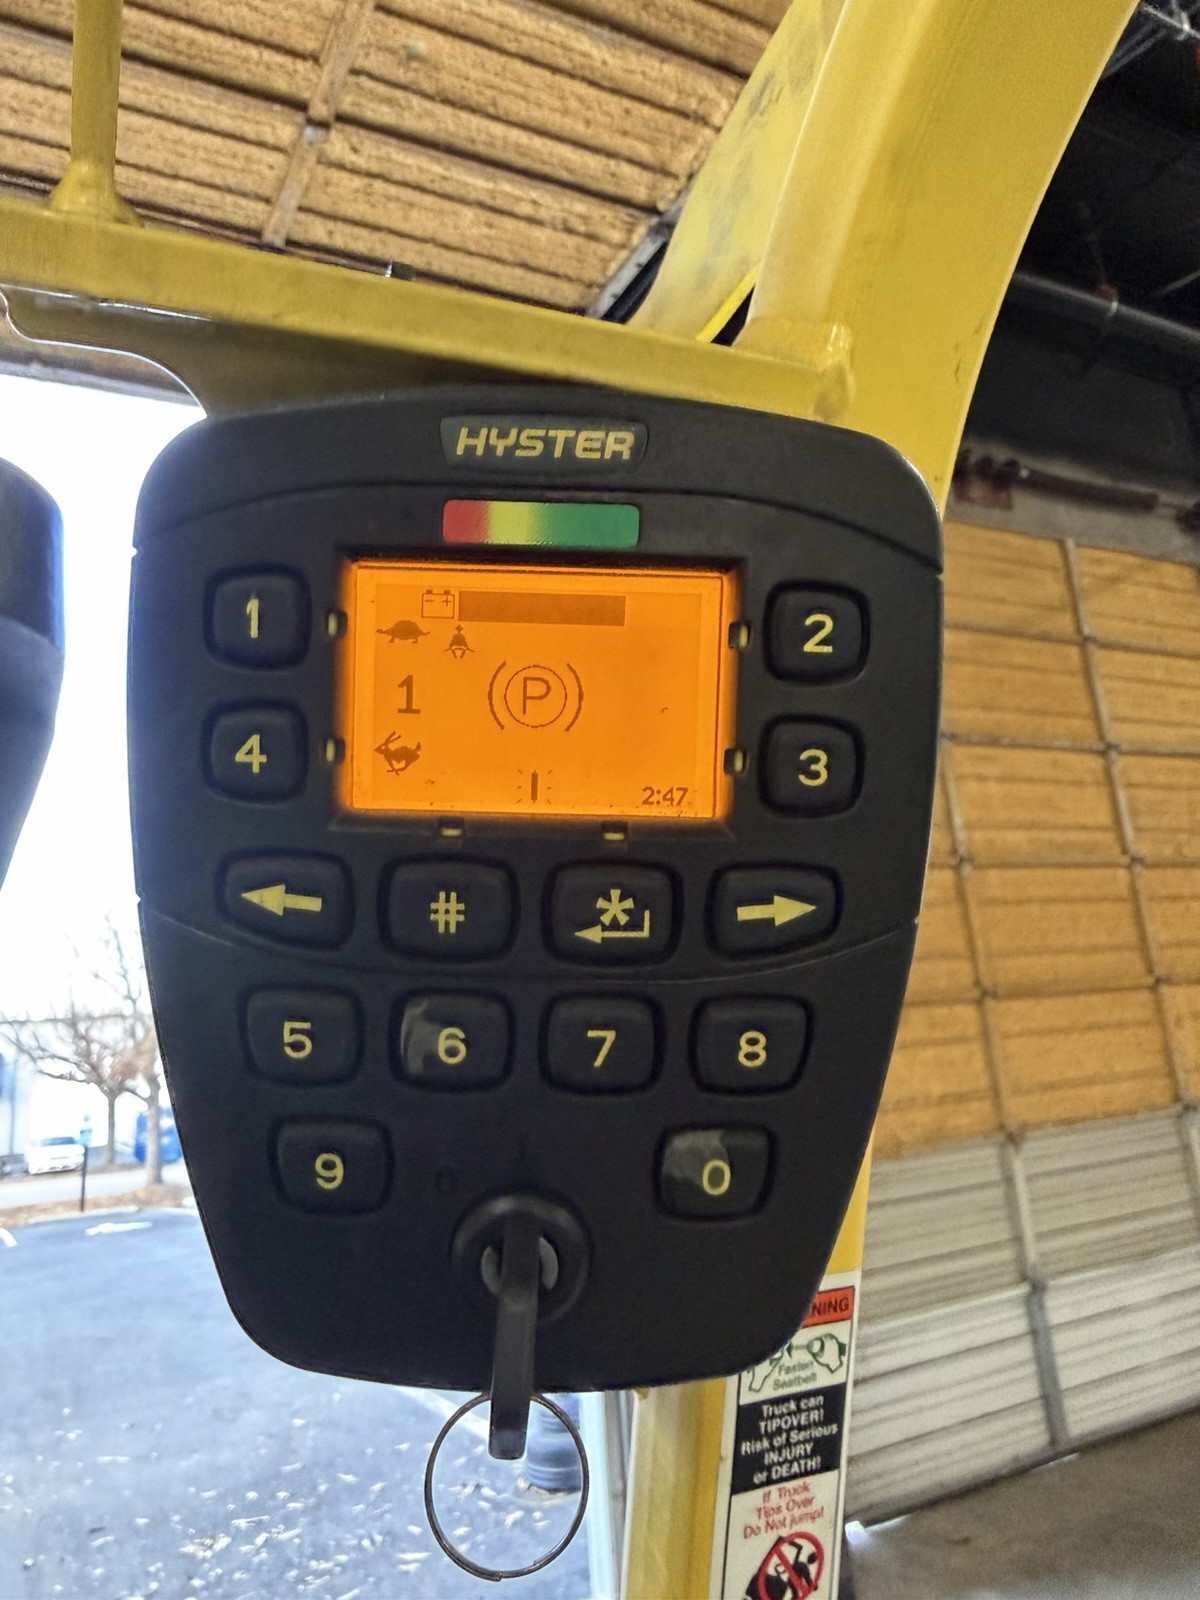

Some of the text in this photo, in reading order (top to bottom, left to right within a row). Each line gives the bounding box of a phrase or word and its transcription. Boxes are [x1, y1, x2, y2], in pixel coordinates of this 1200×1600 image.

[455, 426, 635, 461] HYSTER
[245, 597, 260, 639] 1
[802, 613, 834, 654] 2
[397, 674, 421, 714] 1
[234, 734, 267, 774] 4
[797, 747, 829, 787] 3
[641, 786, 689, 806] 2:47
[283, 1021, 313, 1059] 5
[437, 1027, 467, 1065] 6
[586, 1029, 617, 1068] 7
[737, 1030, 767, 1068] 8
[314, 1152, 344, 1190] 9
[700, 1159, 731, 1195] 0
[811, 1297, 849, 1316] NING
[759, 1408, 824, 1434] TIPOVER!
[762, 1396, 824, 1418] Truck can
[741, 1424, 838, 1455] Risk of Serious
[764, 1442, 814, 1465] INJURY
[753, 1456, 821, 1484] or DEATH!
